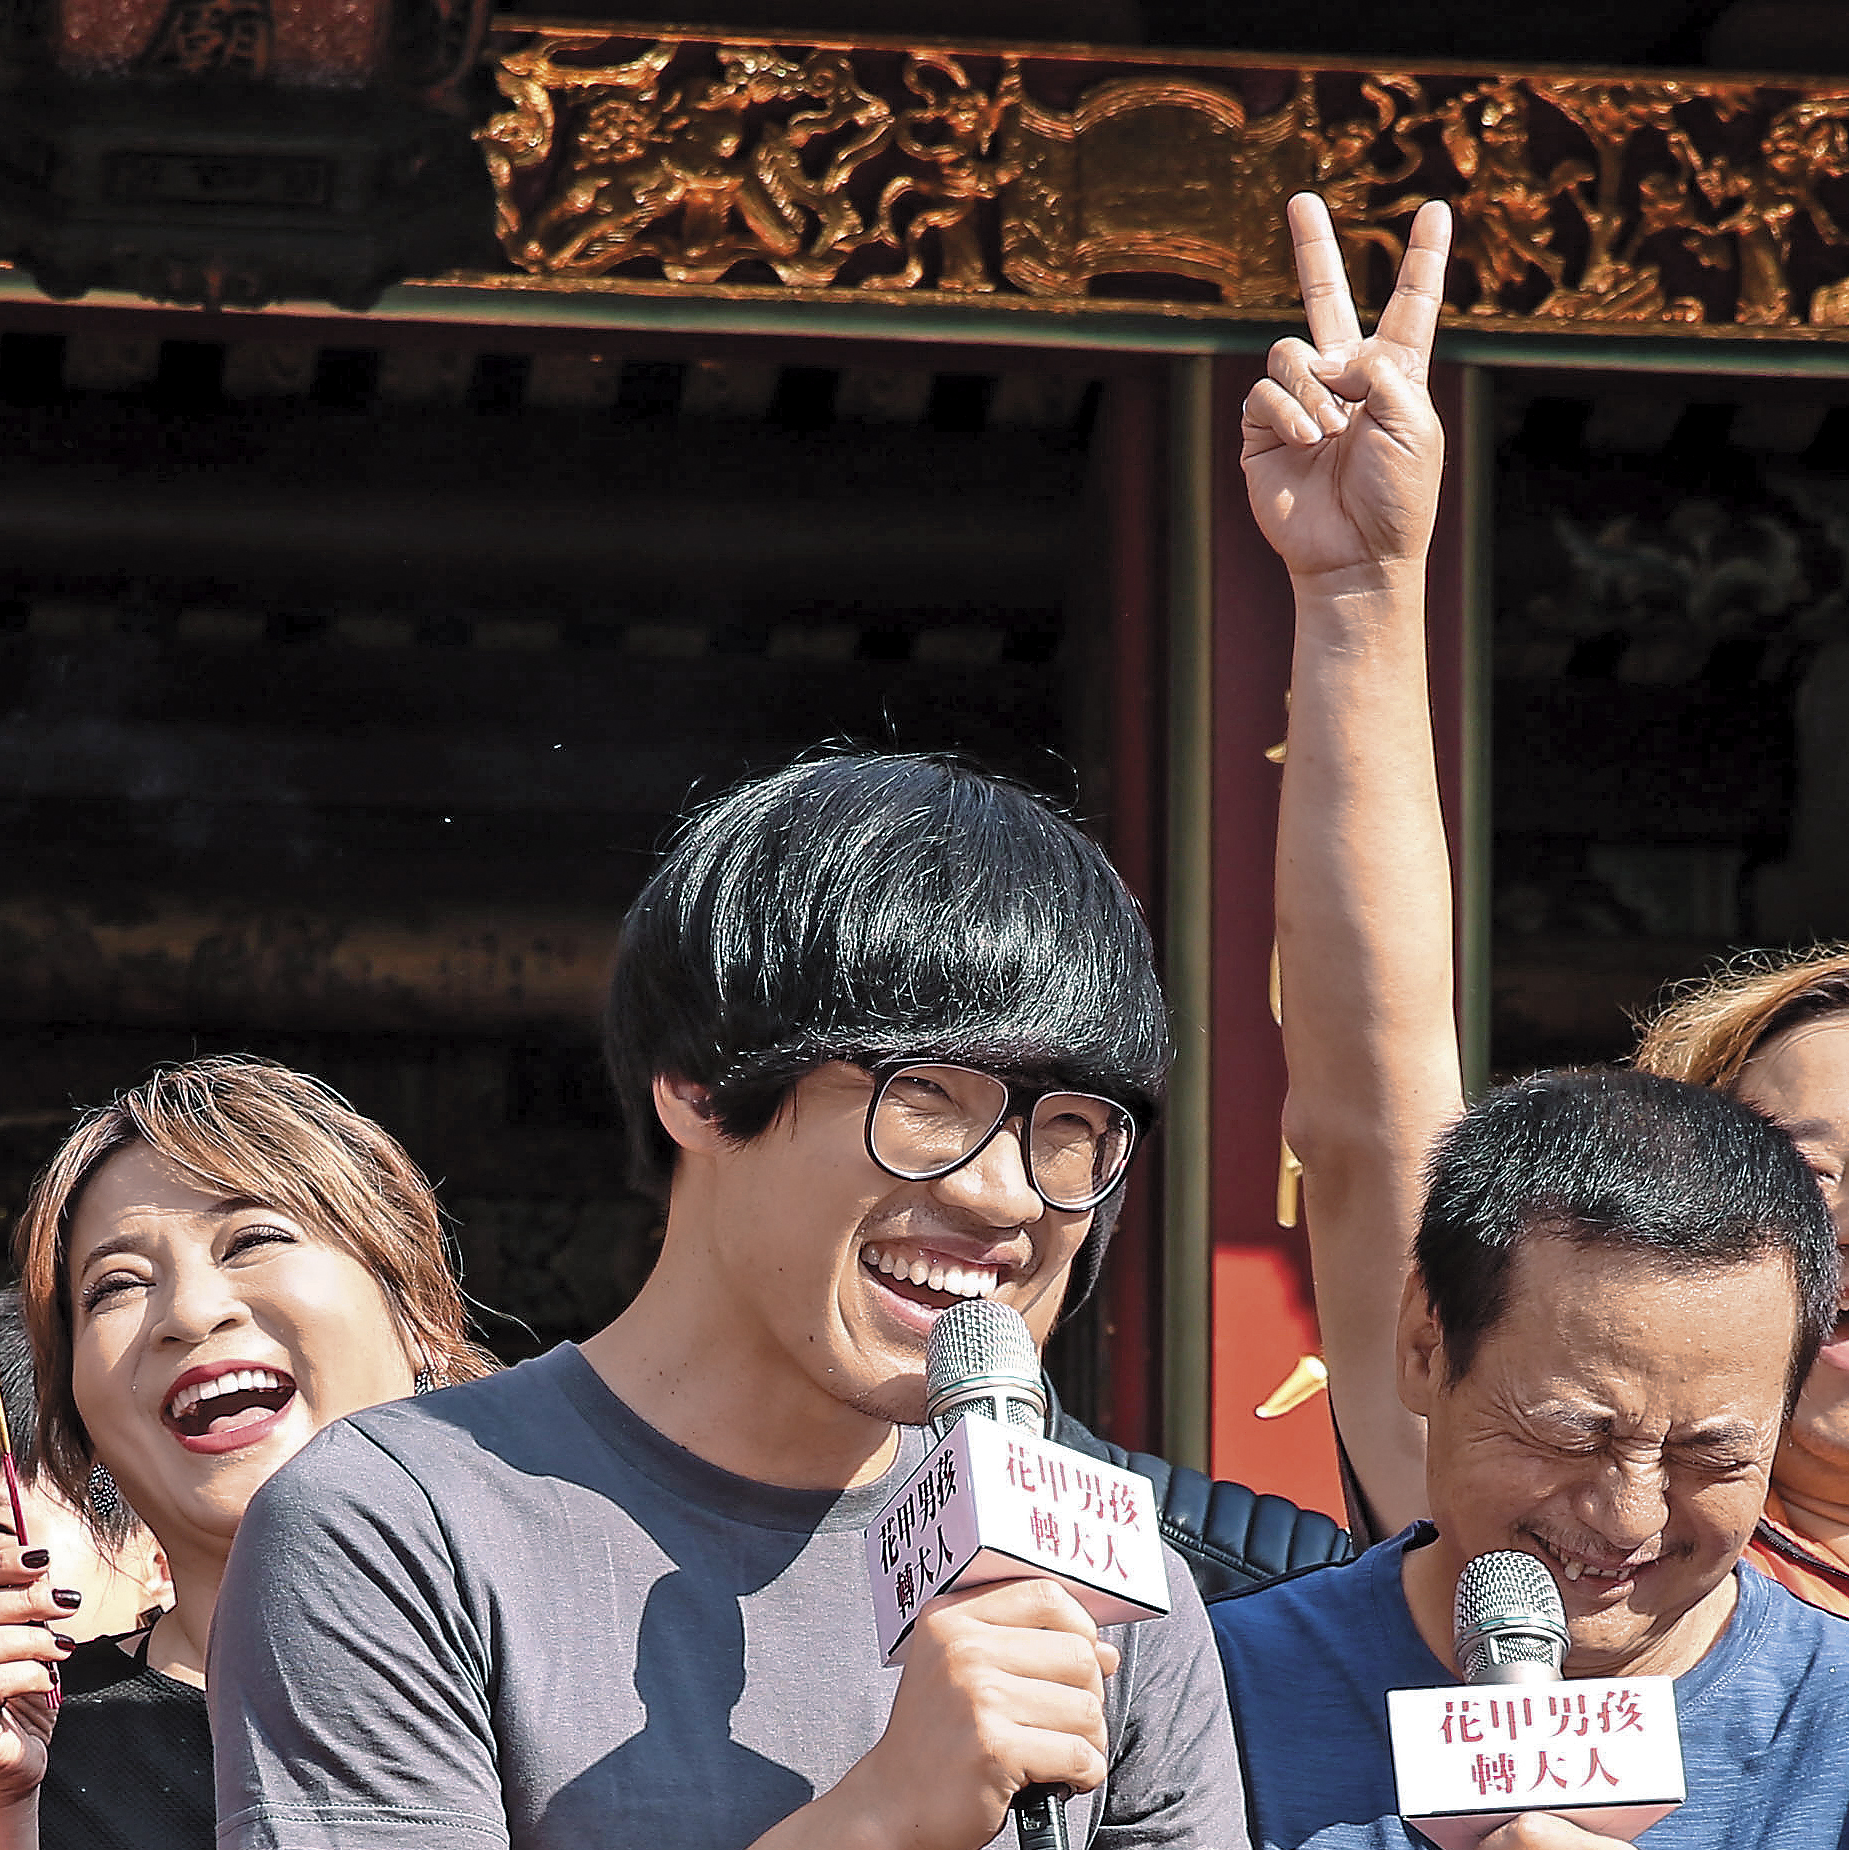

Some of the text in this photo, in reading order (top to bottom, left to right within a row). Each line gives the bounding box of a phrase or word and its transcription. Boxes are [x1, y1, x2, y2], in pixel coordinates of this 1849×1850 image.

[878, 1449, 958, 1575] 花甲男孩
[1006, 1441, 1140, 1533] 花甲男孩
[895, 1525, 954, 1619] 轉大人
[1030, 1506, 1129, 1582] 轉大人
[1439, 1690, 1647, 1745] 花甲男孩
[1472, 1747, 1620, 1796] 轉大人
